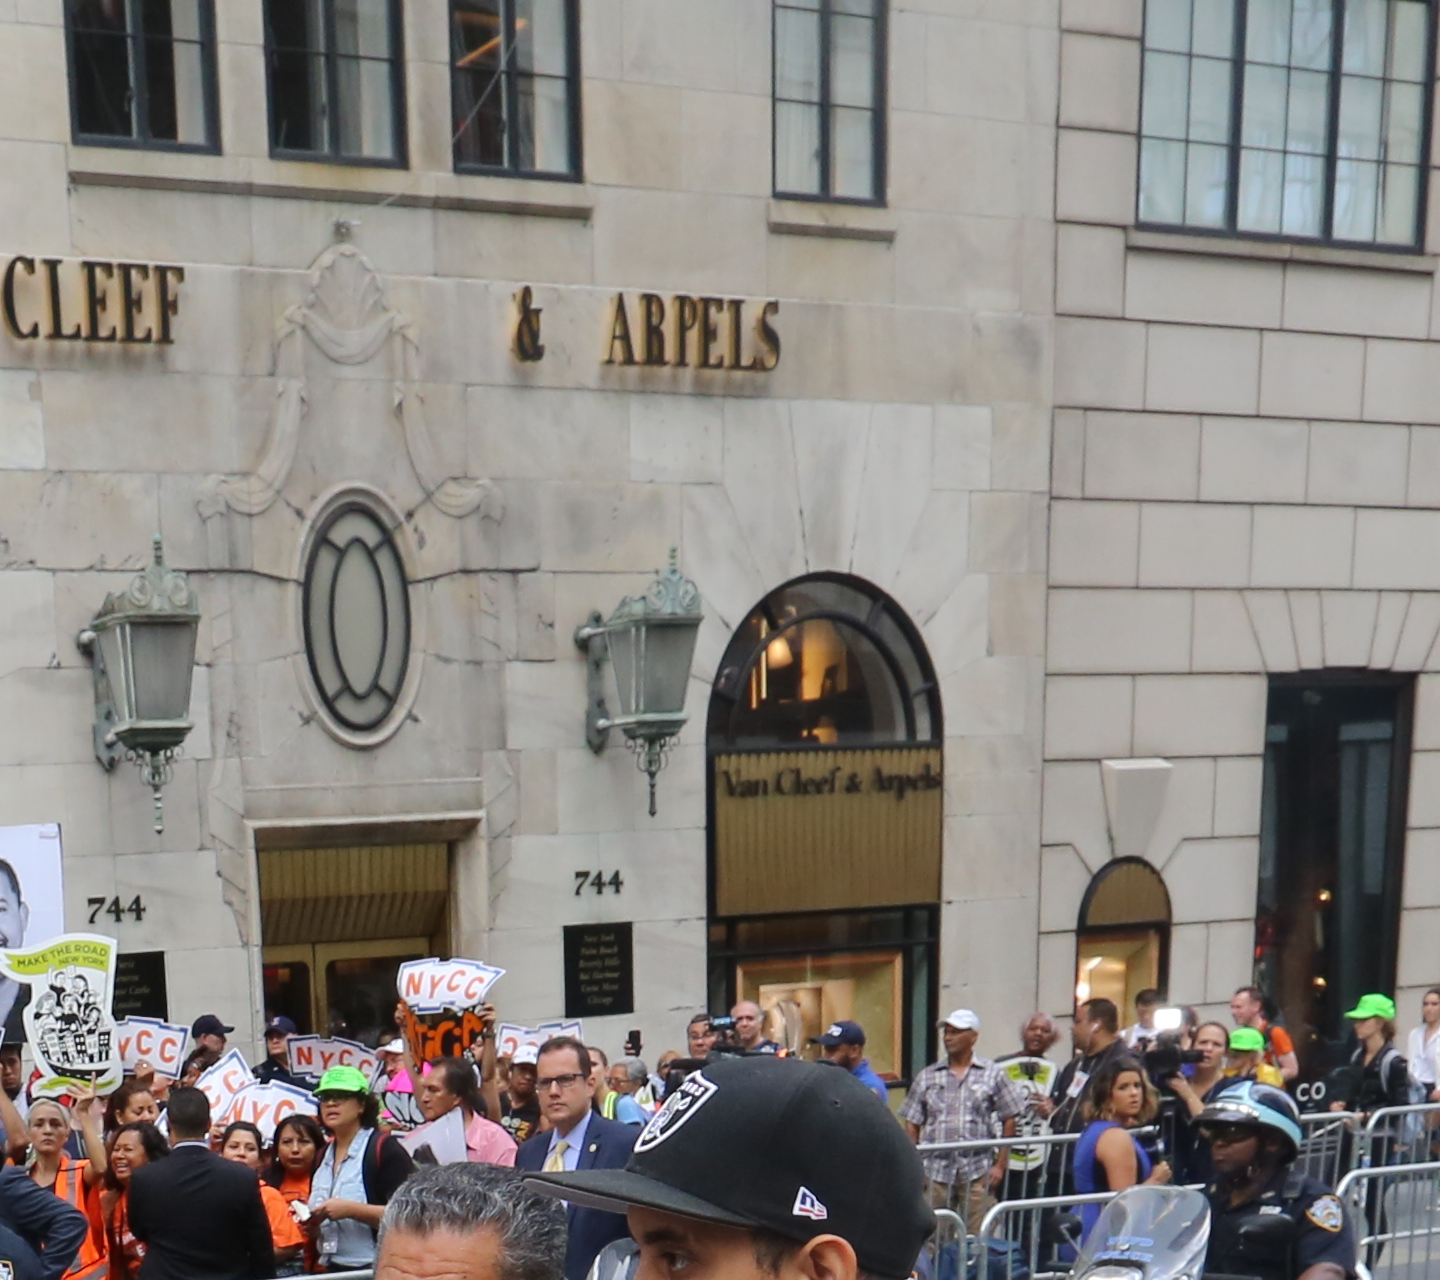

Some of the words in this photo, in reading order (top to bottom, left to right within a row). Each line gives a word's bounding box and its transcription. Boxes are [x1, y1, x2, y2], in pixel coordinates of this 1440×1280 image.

[3, 255, 185, 345] CLEEF
[511, 285, 545, 363] &
[603, 290, 781, 372] ARPELS
[574, 869, 624, 896] 744
[87, 894, 147, 925] 744
[17, 951, 50, 968] MAKE
[50, 944, 72, 961] THE
[73, 943, 108, 957] ROAD
[58, 956, 81, 966] NEW
[82, 956, 106, 967] YORK
[405, 968, 484, 1000] NYCC
[118, 1029, 178, 1063] YCC
[225, 1095, 319, 1127] NYC
